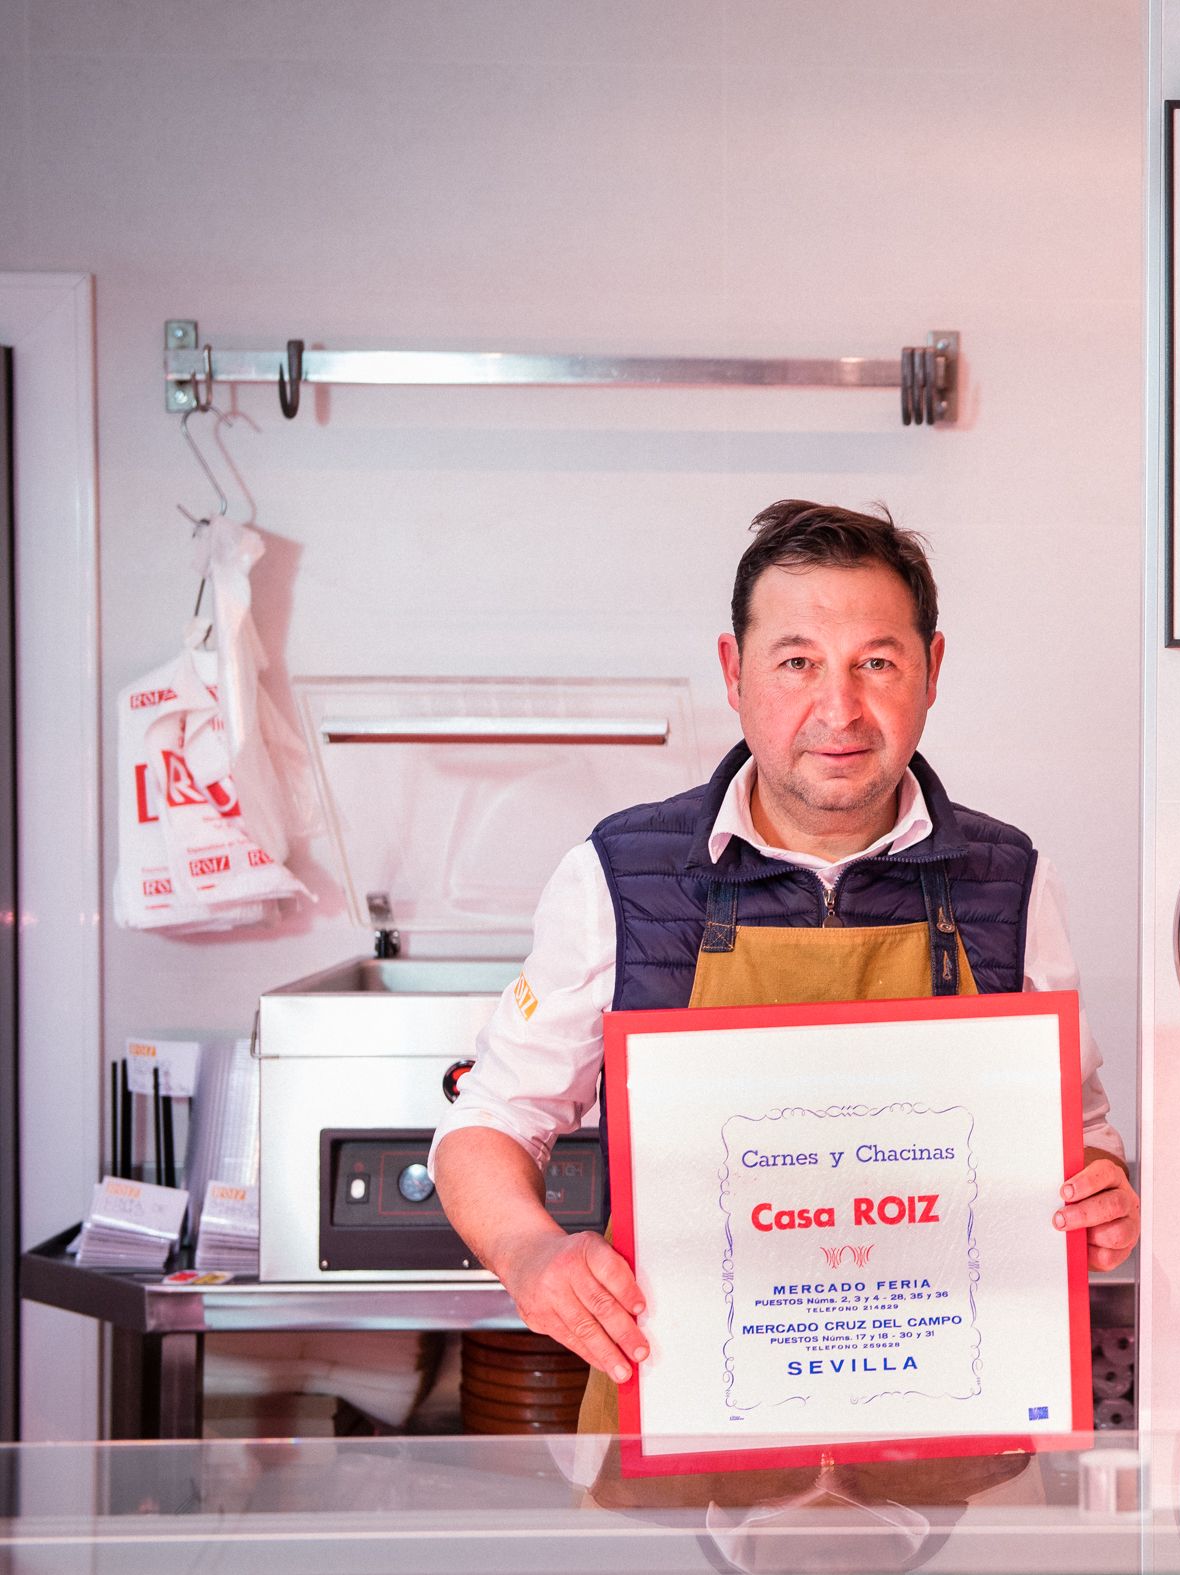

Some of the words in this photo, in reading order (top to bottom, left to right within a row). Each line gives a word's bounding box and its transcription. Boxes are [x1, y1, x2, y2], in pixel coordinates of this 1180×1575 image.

[741, 1149, 819, 1168] Carnes
[830, 1151, 844, 1168] y
[856, 1144, 956, 1162] Chacinas
[751, 1202, 836, 1232] Casa
[853, 1194, 940, 1226] ROIZ
[773, 1282, 866, 1296] MERCADO
[876, 1278, 932, 1290] FERIA
[754, 1298, 804, 1307] PUESTOS
[854, 1295, 861, 1303] 3
[864, 1296, 870, 1304] y
[872, 1294, 879, 1302] 4
[926, 1293, 932, 1301] y
[935, 1290, 949, 1298] 36
[806, 1305, 859, 1314] TELEFONO
[742, 1322, 819, 1335] MERCADO
[824, 1320, 868, 1331] CRUZ
[872, 1318, 902, 1330] DEL
[907, 1315, 963, 1328] CAMPO
[770, 1336, 819, 1345] PUESTOS
[856, 1333, 866, 1341] 17
[869, 1334, 875, 1342] y
[878, 1332, 889, 1340] 18
[899, 1331, 913, 1339] 30
[916, 1332, 922, 1340] y
[925, 1330, 935, 1338] 31
[806, 1343, 858, 1352] TELEFONO
[787, 1356, 918, 1376] SEVILLA
